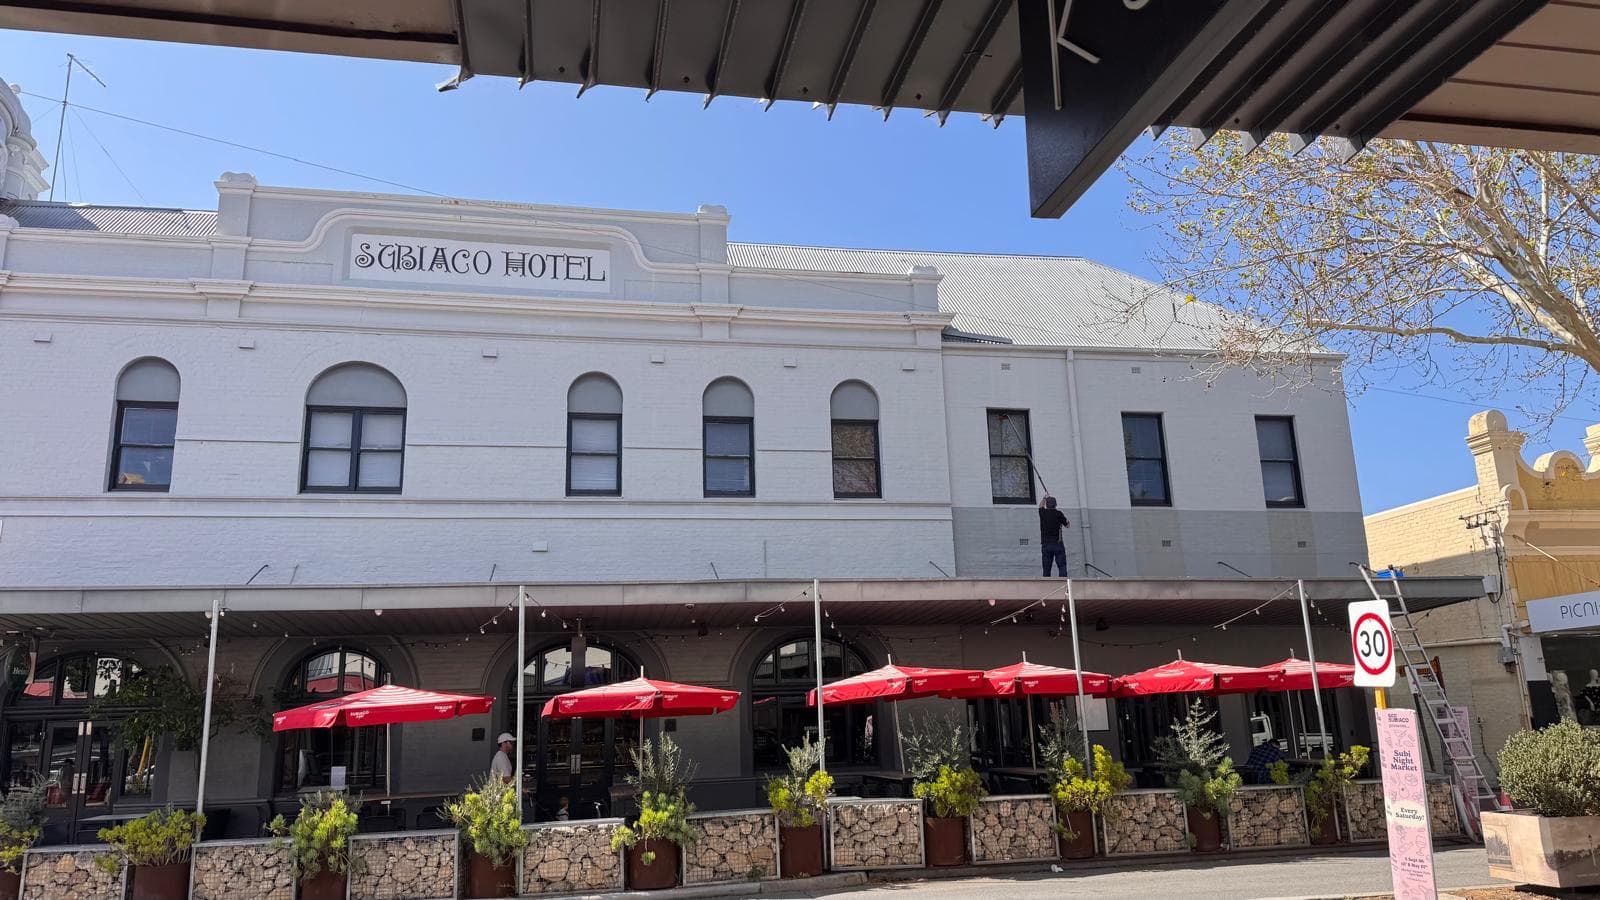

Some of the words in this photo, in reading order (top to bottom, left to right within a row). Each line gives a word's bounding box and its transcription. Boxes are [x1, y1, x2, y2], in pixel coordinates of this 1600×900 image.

[354, 242, 492, 275] SUBIACO
[501, 250, 606, 282] HOTEL
[1560, 601, 1600, 619] PICNI
[1360, 629, 1385, 657] 30
[1393, 757, 1413, 765] Night
[1395, 812, 1424, 821] Saturday!
